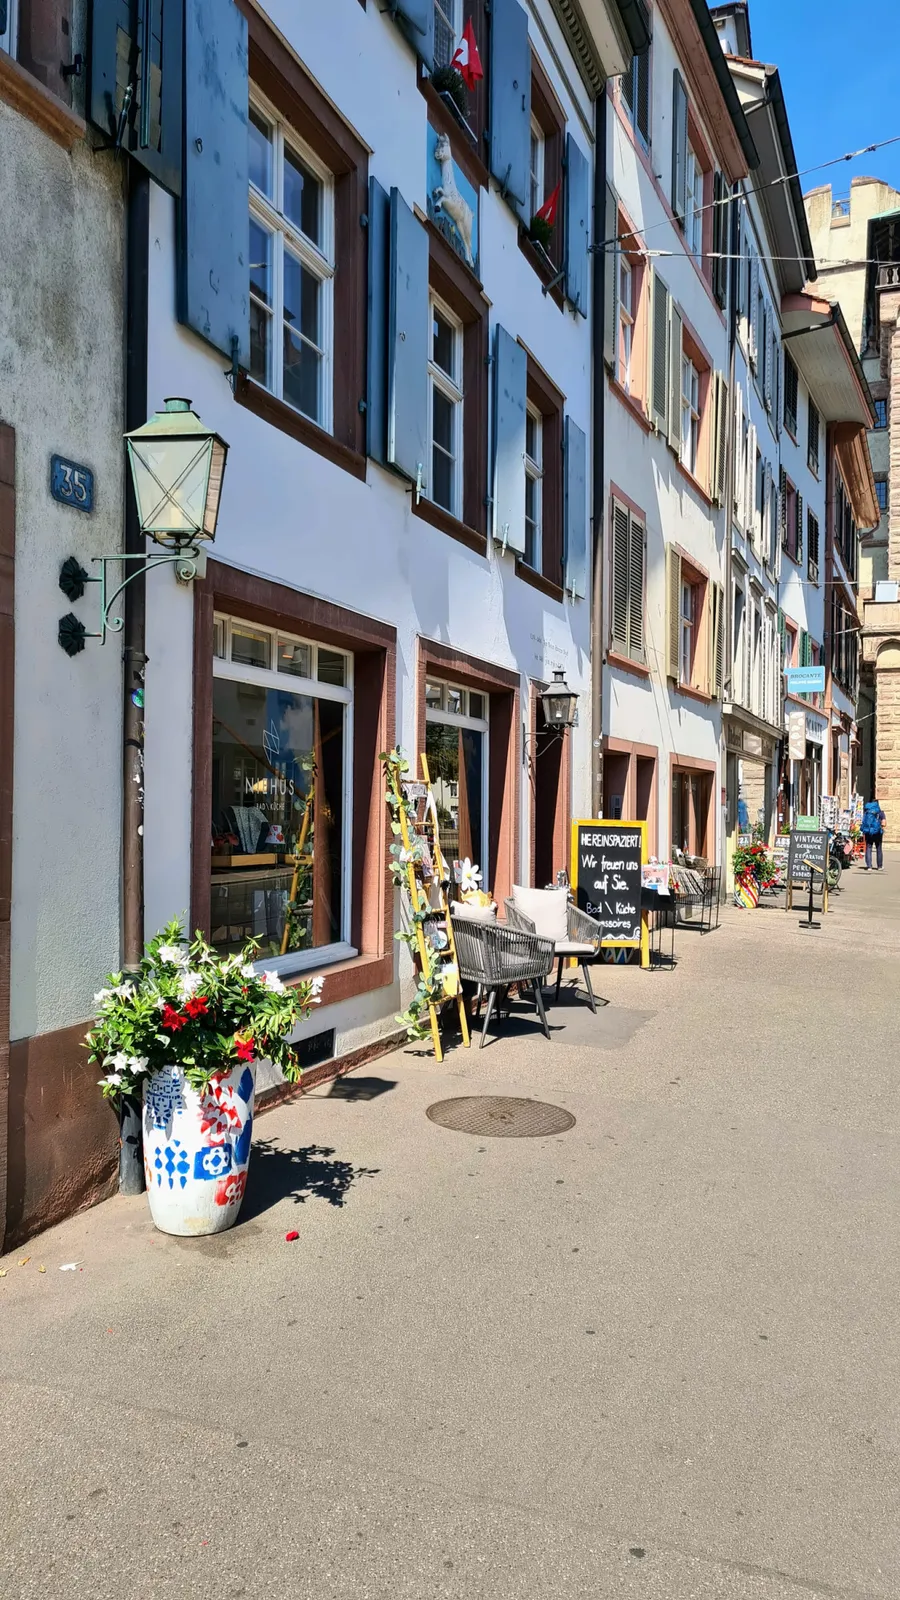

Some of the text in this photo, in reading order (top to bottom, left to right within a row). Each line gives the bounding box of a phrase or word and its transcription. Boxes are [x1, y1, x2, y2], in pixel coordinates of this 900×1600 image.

[60, 464, 87, 502] 35
[245, 776, 295, 796] NIEHUS
[794, 835, 824, 844] VINTAGE
[581, 854, 639, 872] Wir freuen uns
[594, 874, 629, 894] auf Sie.
[586, 902, 602, 914] Bad
[615, 901, 636, 915] Küche
